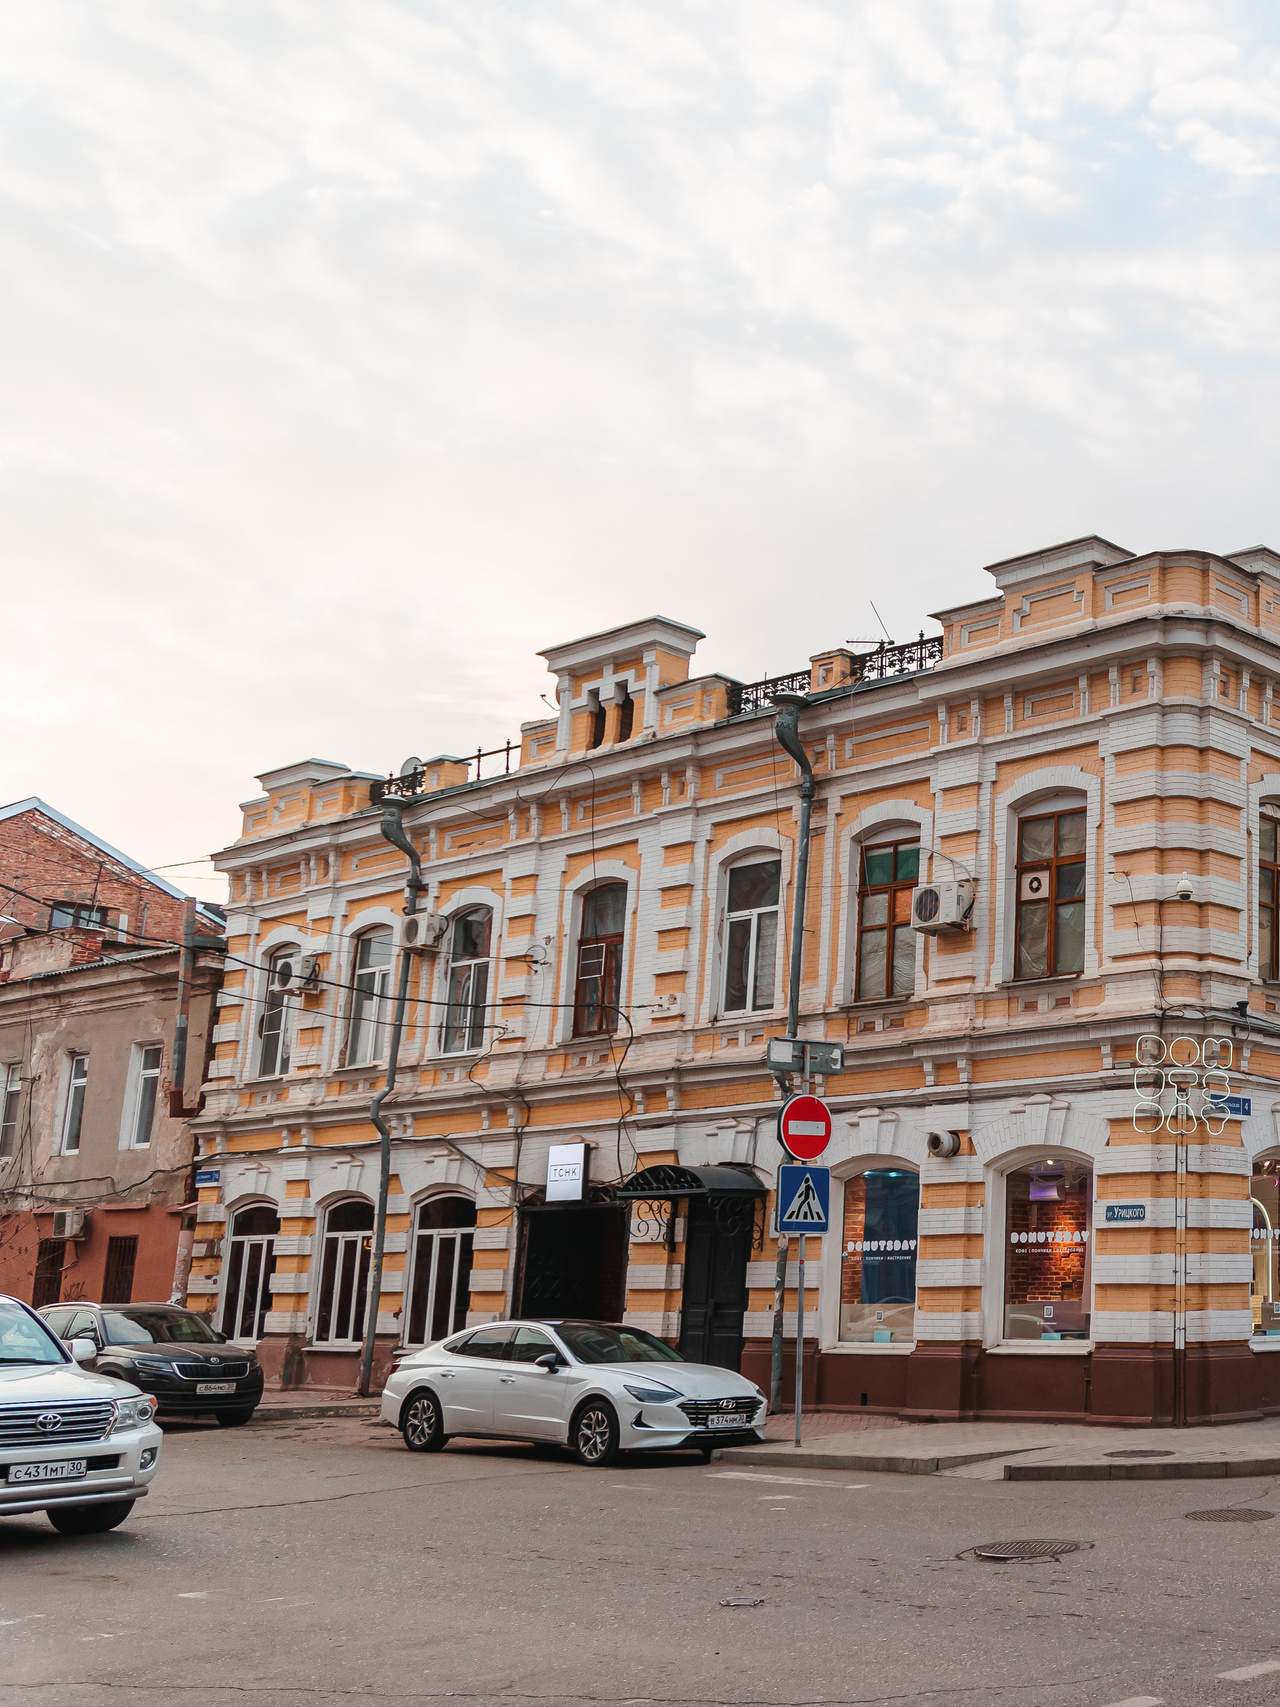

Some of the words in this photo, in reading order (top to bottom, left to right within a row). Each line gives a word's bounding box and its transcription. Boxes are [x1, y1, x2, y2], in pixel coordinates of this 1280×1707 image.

[1244, 1101, 1249, 1111] 4
[553, 1167, 577, 1178] TCHK
[1010, 1230, 1090, 1244] DONUTSDAY
[847, 1239, 917, 1253] DONUTSDAY
[14, 1464, 66, 1480] С431МТ
[69, 1461, 82, 1472] 30
